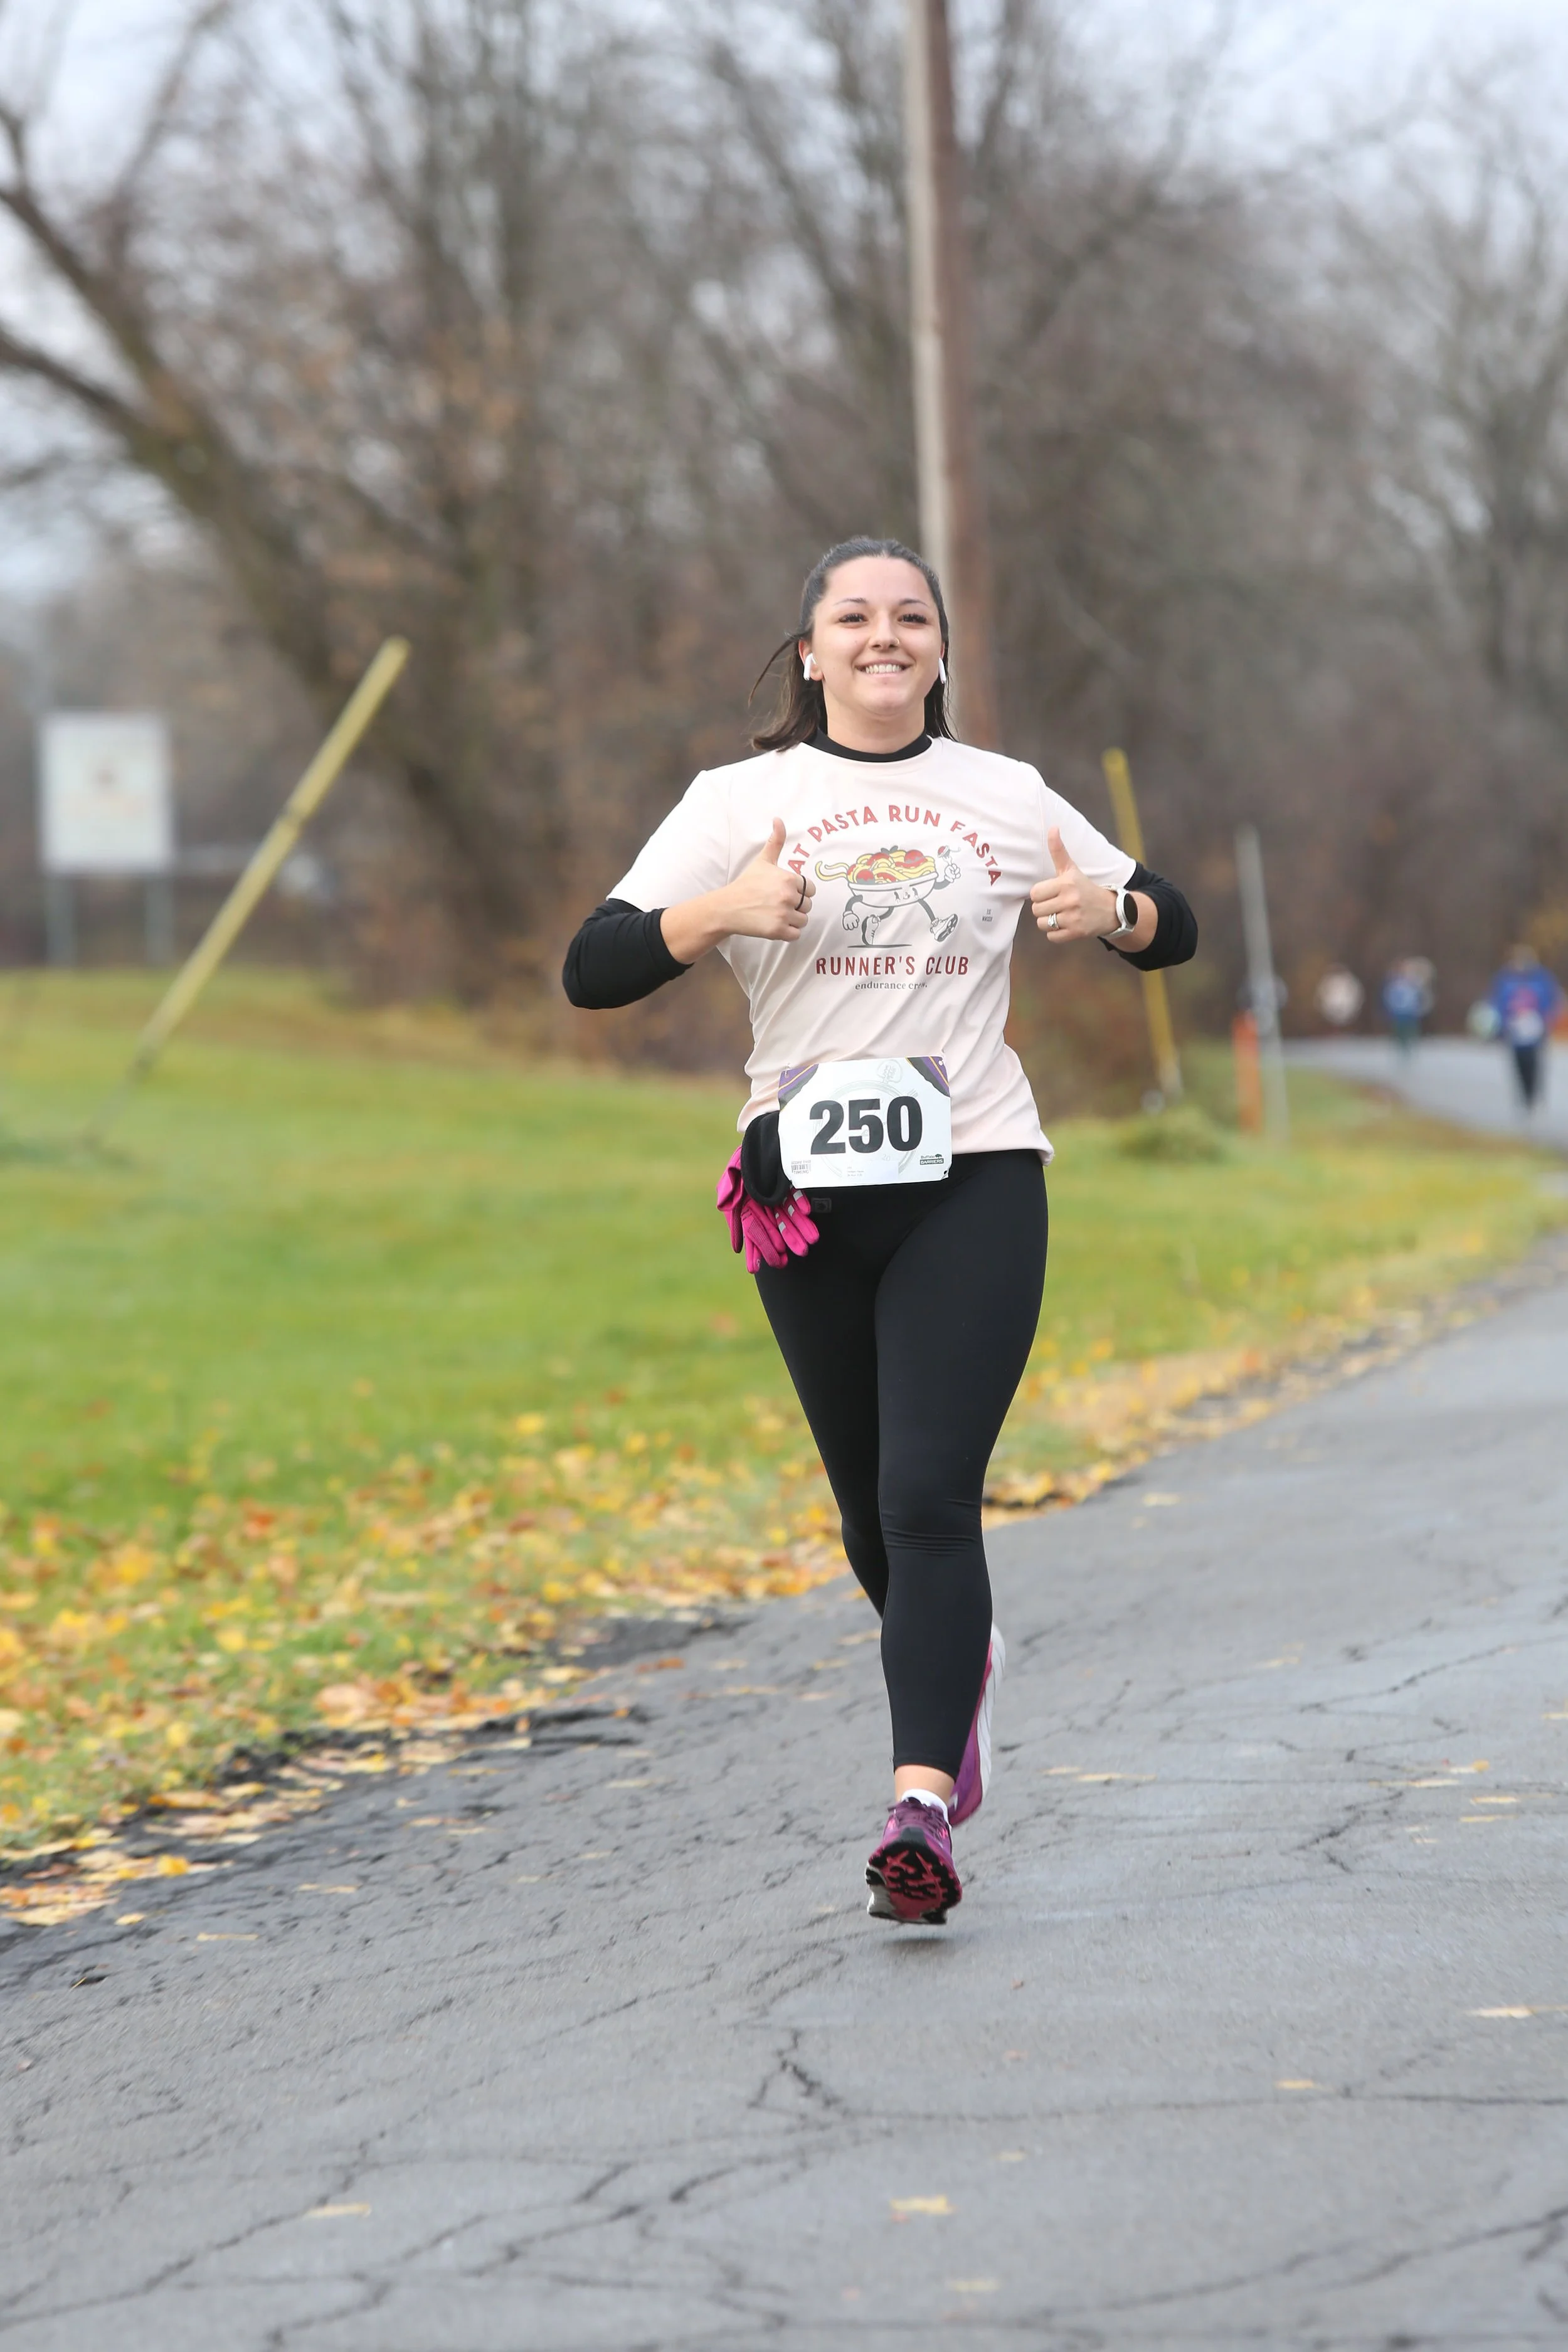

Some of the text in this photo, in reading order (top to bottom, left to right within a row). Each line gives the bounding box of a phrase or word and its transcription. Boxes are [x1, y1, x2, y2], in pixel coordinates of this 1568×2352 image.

[788, 805, 1002, 886] AT PASTA RUN FASTA
[815, 956, 969, 977] RUNNER'S CLUB
[855, 980, 906, 990] endurance
[810, 1096, 923, 1155] 250
